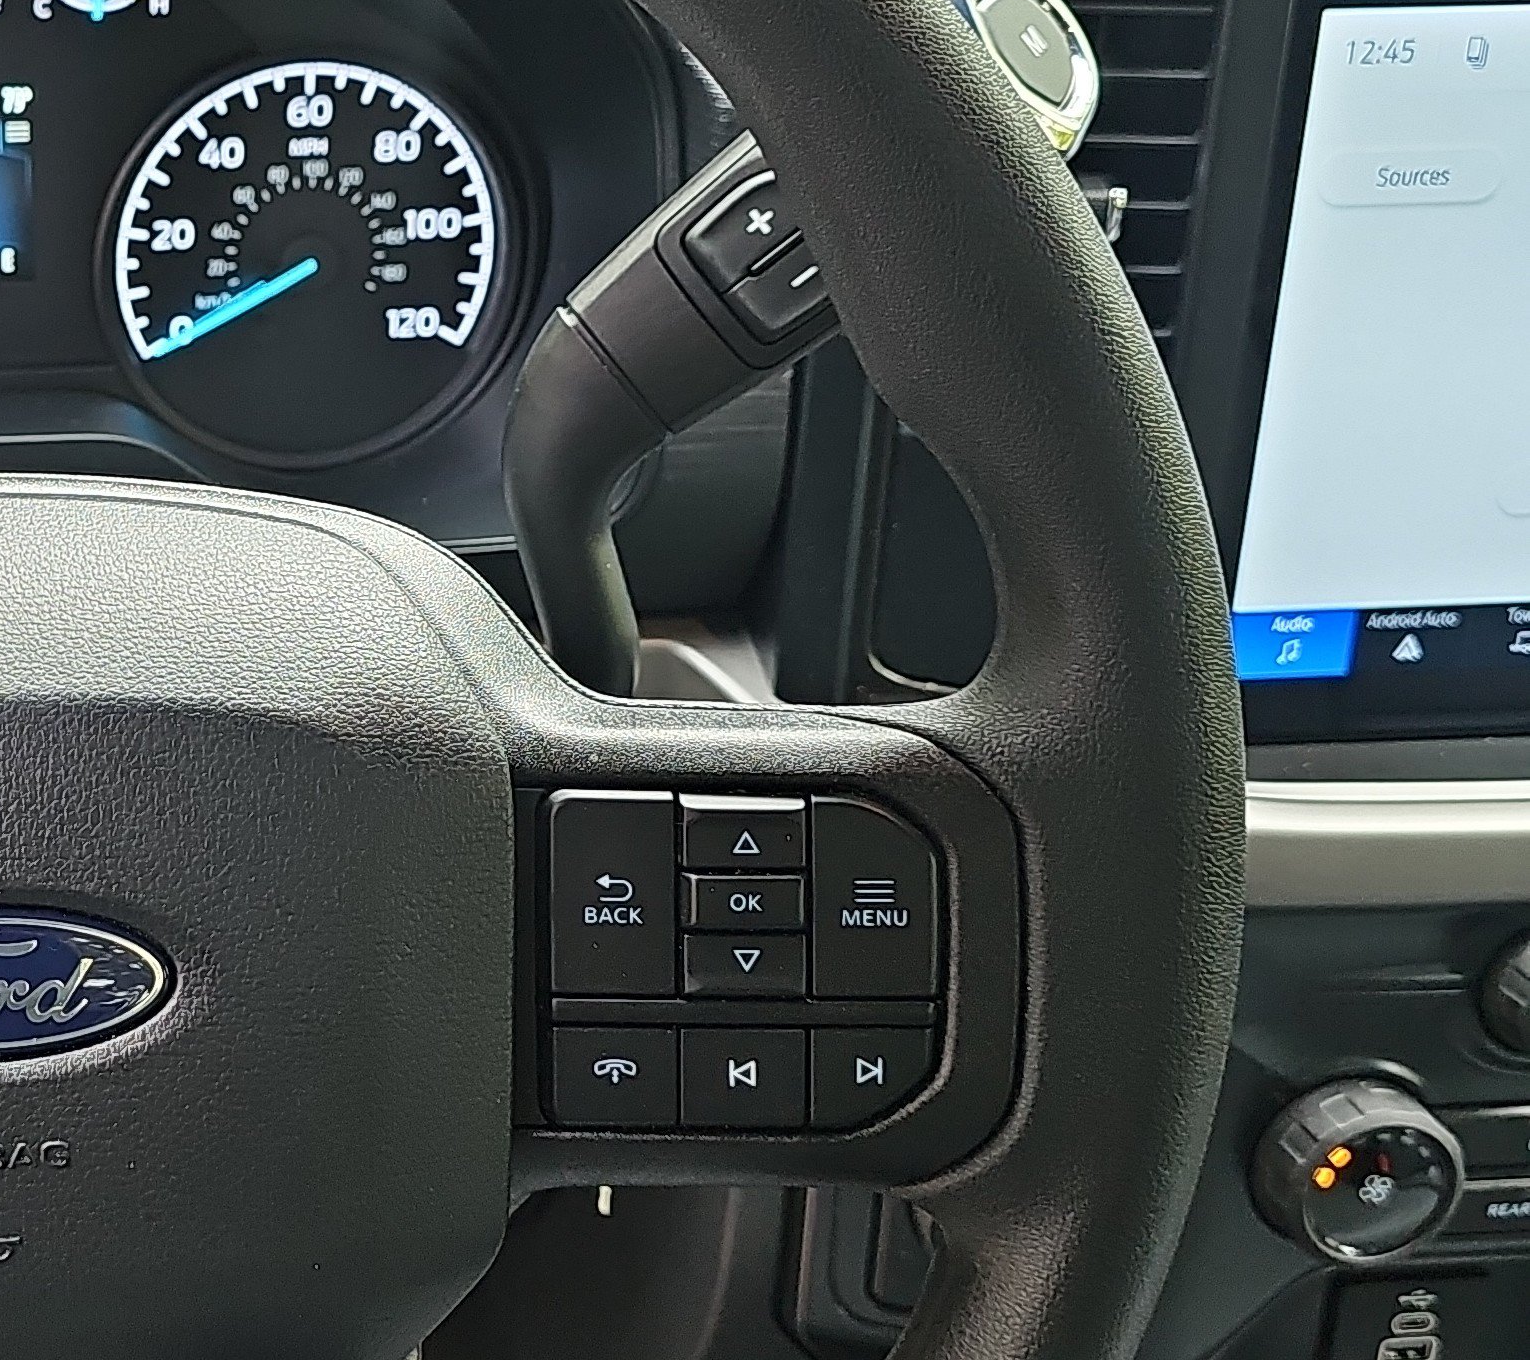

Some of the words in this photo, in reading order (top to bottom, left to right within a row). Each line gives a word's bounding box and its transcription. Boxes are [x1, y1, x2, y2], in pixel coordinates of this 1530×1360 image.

[1346, 38, 1417, 66] 12:45
[286, 95, 333, 127] 60
[198, 136, 245, 169] 40
[374, 130, 421, 162] 80
[1376, 166, 1451, 188] Sources
[151, 219, 196, 251] 20
[403, 208, 462, 240] 100
[386, 307, 440, 339] 120
[1271, 615, 1314, 632] Audio
[1366, 611, 1420, 630] Android
[1421, 610, 1462, 628] Auto
[584, 907, 643, 925] BACK
[729, 894, 763, 913] OK
[841, 909, 908, 927] MENU
